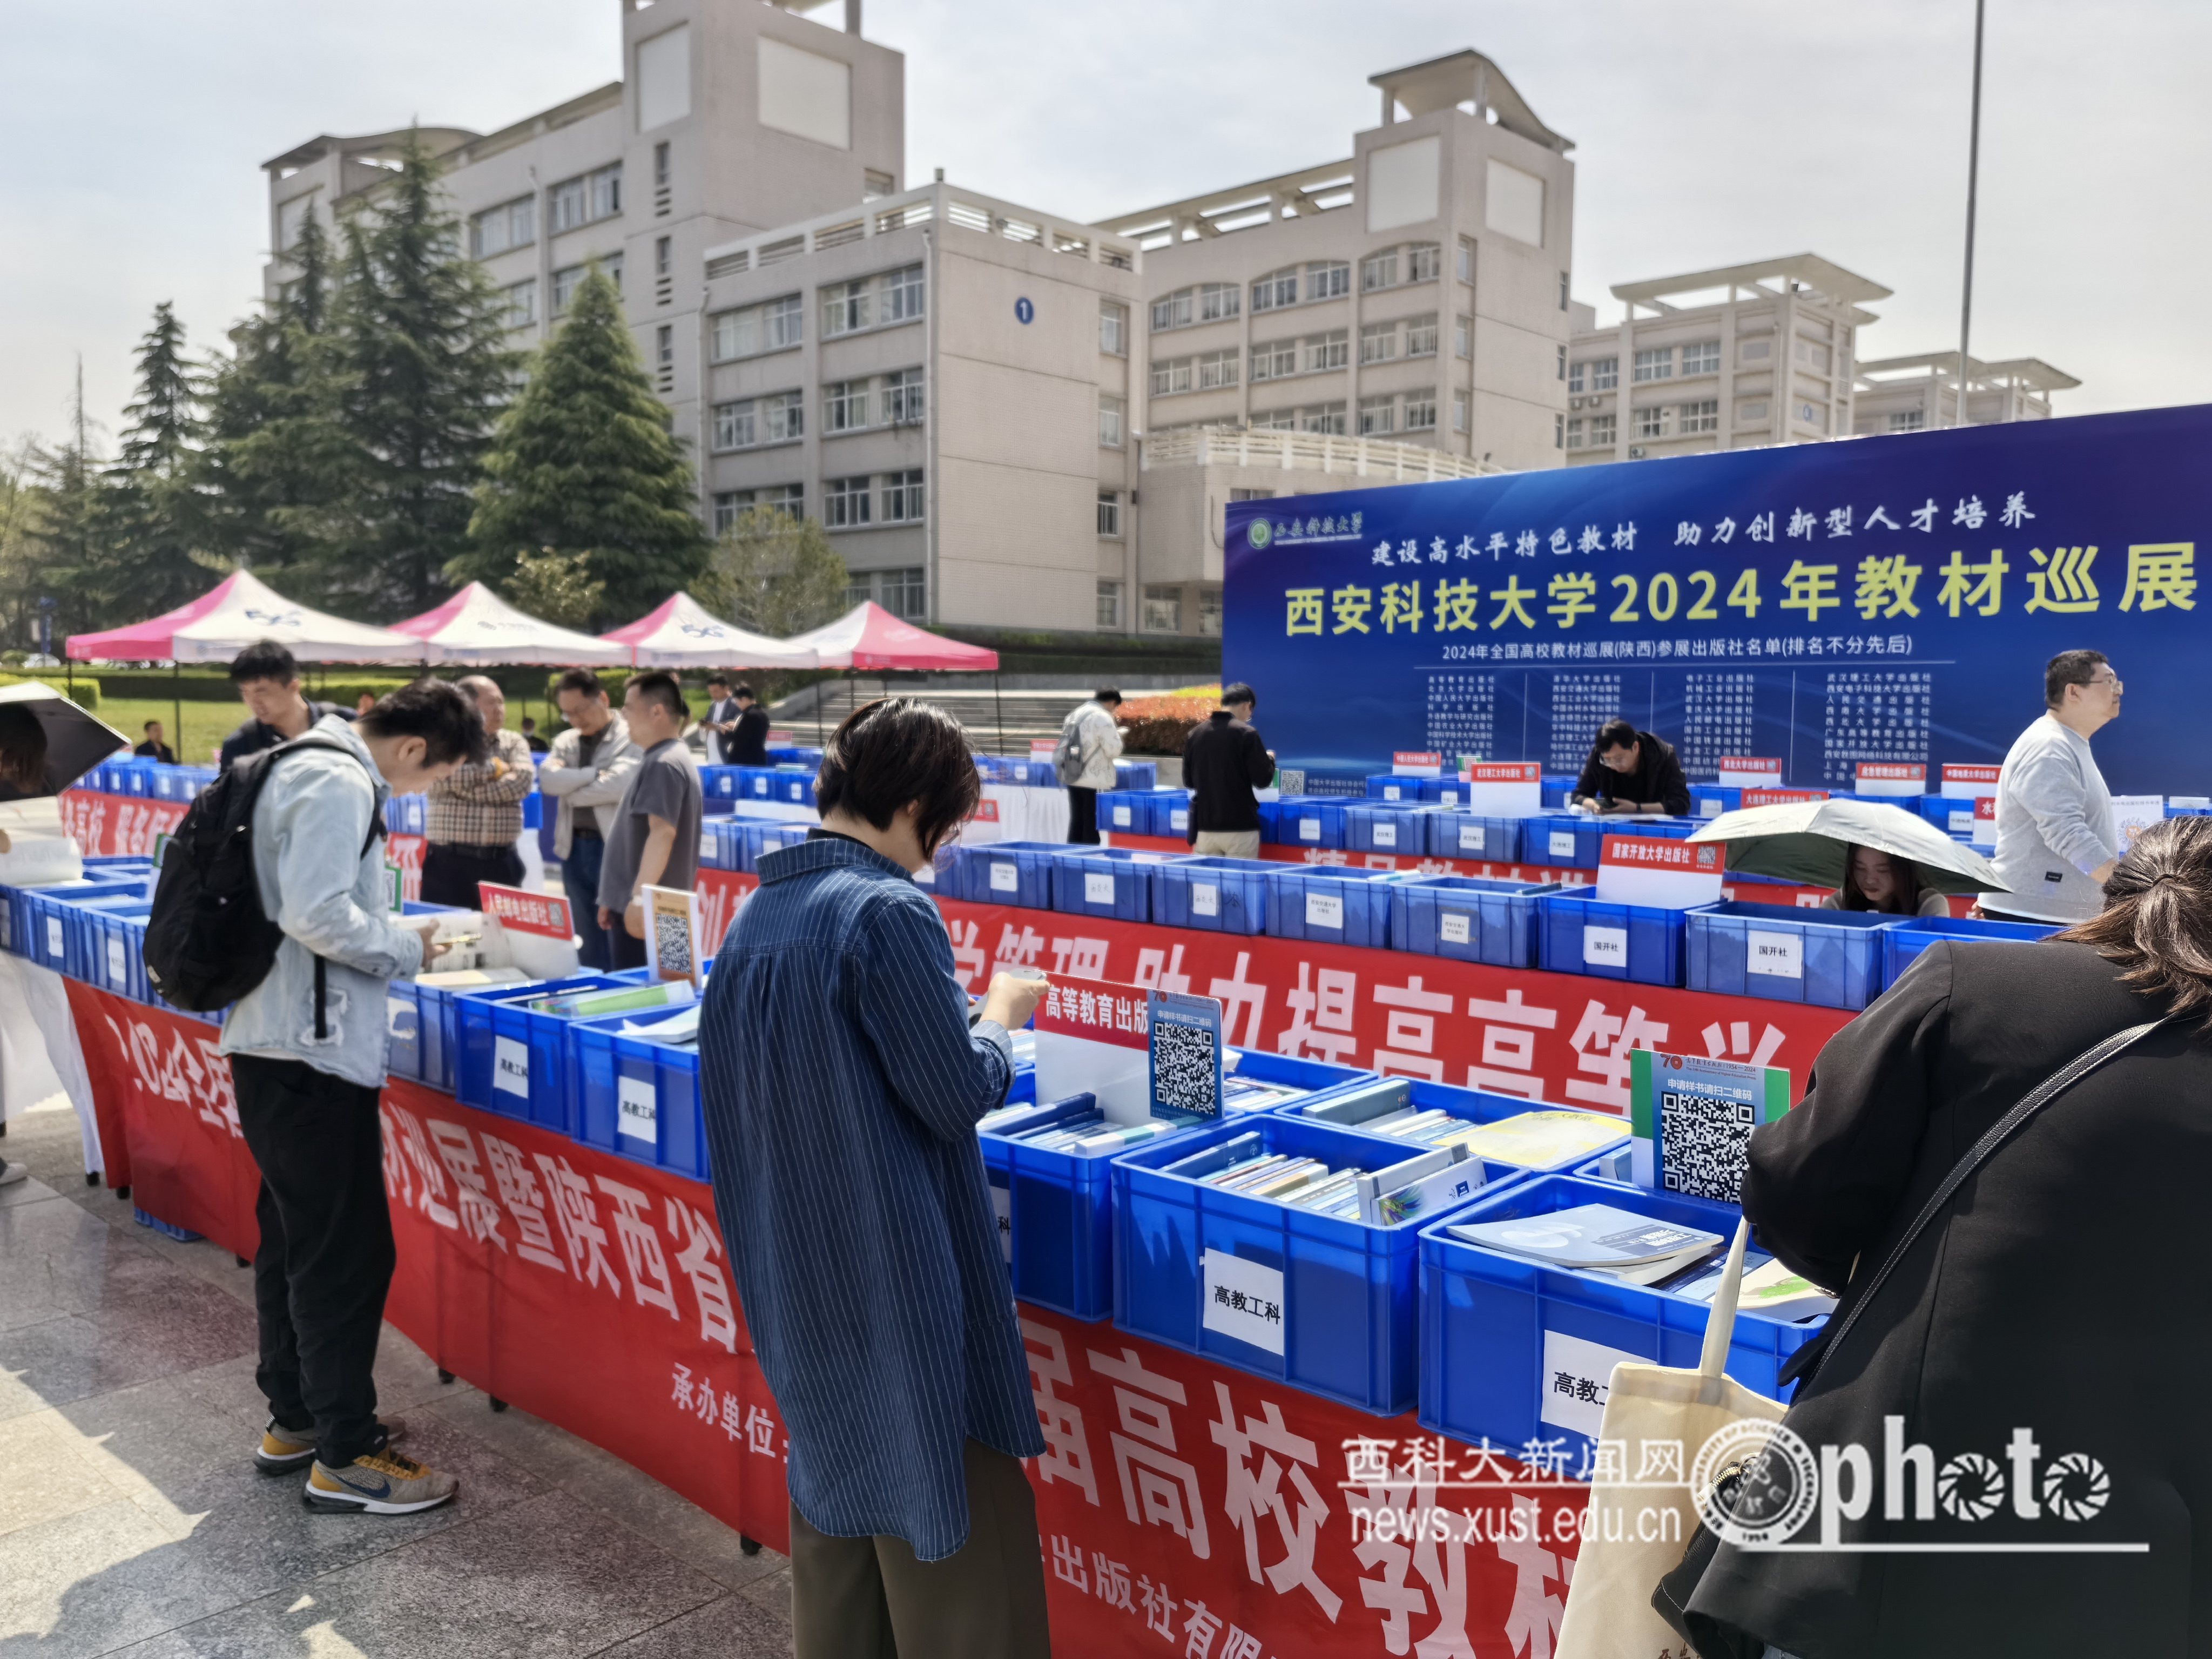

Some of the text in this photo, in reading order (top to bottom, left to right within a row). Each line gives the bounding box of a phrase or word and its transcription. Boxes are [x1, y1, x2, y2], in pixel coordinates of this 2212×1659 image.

[1020, 301, 1028, 321] 1
[1371, 490, 2035, 566] 建设高水平特色教材 助力创新型人才培养
[1285, 542, 2198, 636] 西安科技大学2024年教材巡展
[1442, 634, 1912, 660] 2024年全国高校教材巡展(陕西)参展出版社名单(排名不分先后)
[1477, 768, 1520, 778] 武汉理工大学出版社
[1612, 842, 1690, 864] 国家开放大学出版社
[1311, 900, 1337, 908] 西安交通大学
[1594, 941, 1618, 953] 国开社
[1759, 945, 1788, 957] 国开社
[1046, 983, 1149, 1034] 高等教育出版
[1157, 1009, 1212, 1028] 申请样书请扫二维码
[1668, 1078, 1751, 1100] 申请样书请扫二维码
[997, 1216, 1011, 1235] 科
[1214, 1285, 1281, 1325] 高教工科
[1038, 1533, 1280, 1659] 出版社有限
